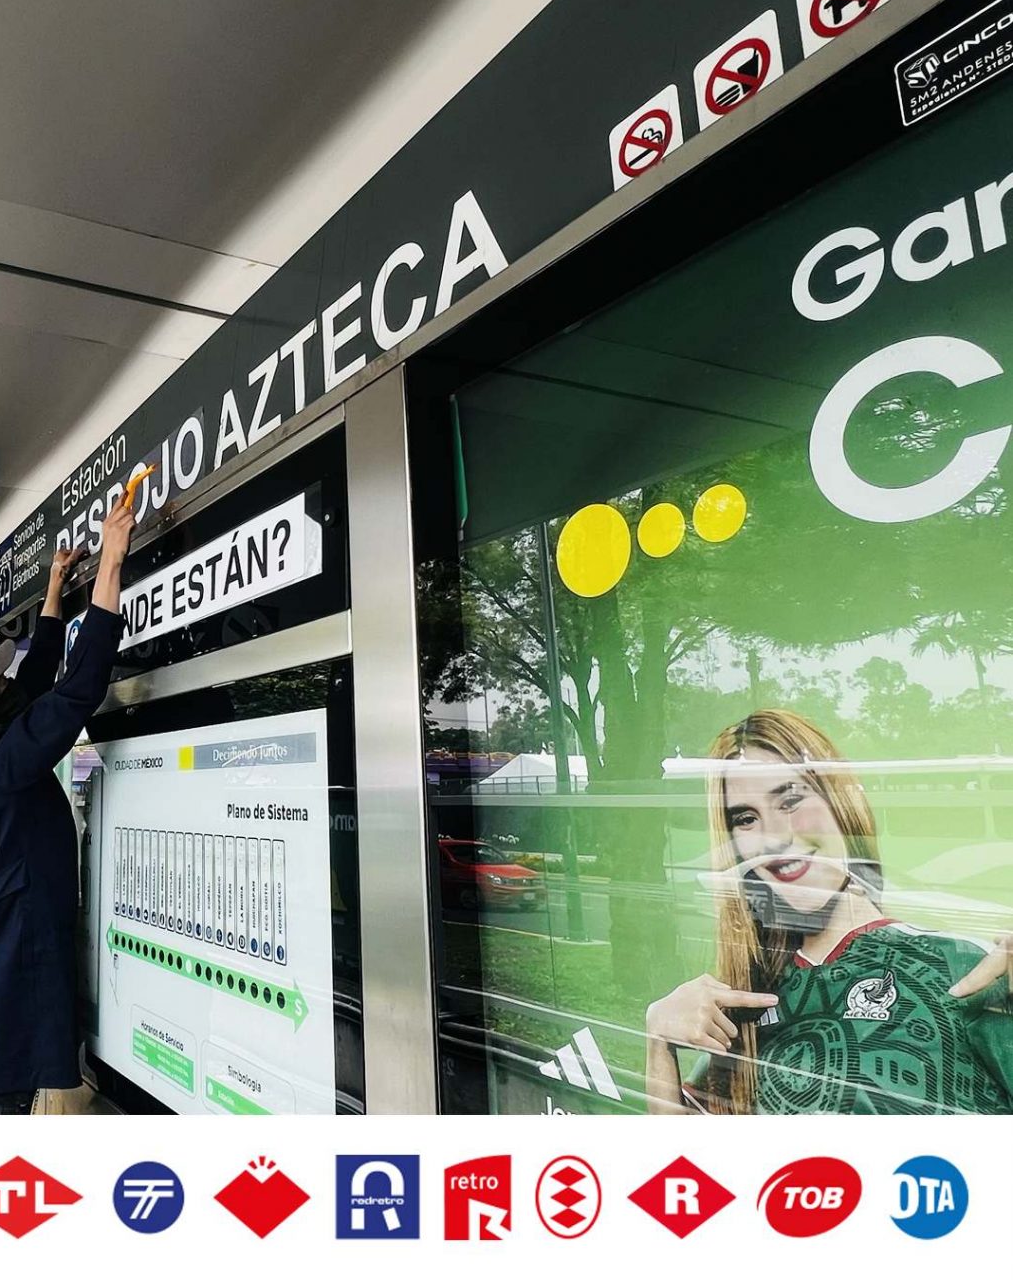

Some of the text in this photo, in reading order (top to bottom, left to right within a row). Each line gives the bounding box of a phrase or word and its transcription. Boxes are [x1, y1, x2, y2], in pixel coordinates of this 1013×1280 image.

[943, 13, 1013, 63] CINCO
[942, 40, 1013, 89] ANDENES
[911, 81, 967, 116] Expediente
[214, 189, 509, 471] AZTECA
[61, 434, 127, 517] Estación
[13, 511, 45, 551] Servicio de
[13, 533, 47, 571] Transportes
[12, 560, 40, 592] Eléctricos
[122, 519, 291, 641] NDE ESTÁN?
[114, 756, 163, 771] CIUDAD DE MÉXICO
[227, 803, 309, 821] Plano de Sistema
[165, 1033, 185, 1052] Servicio
